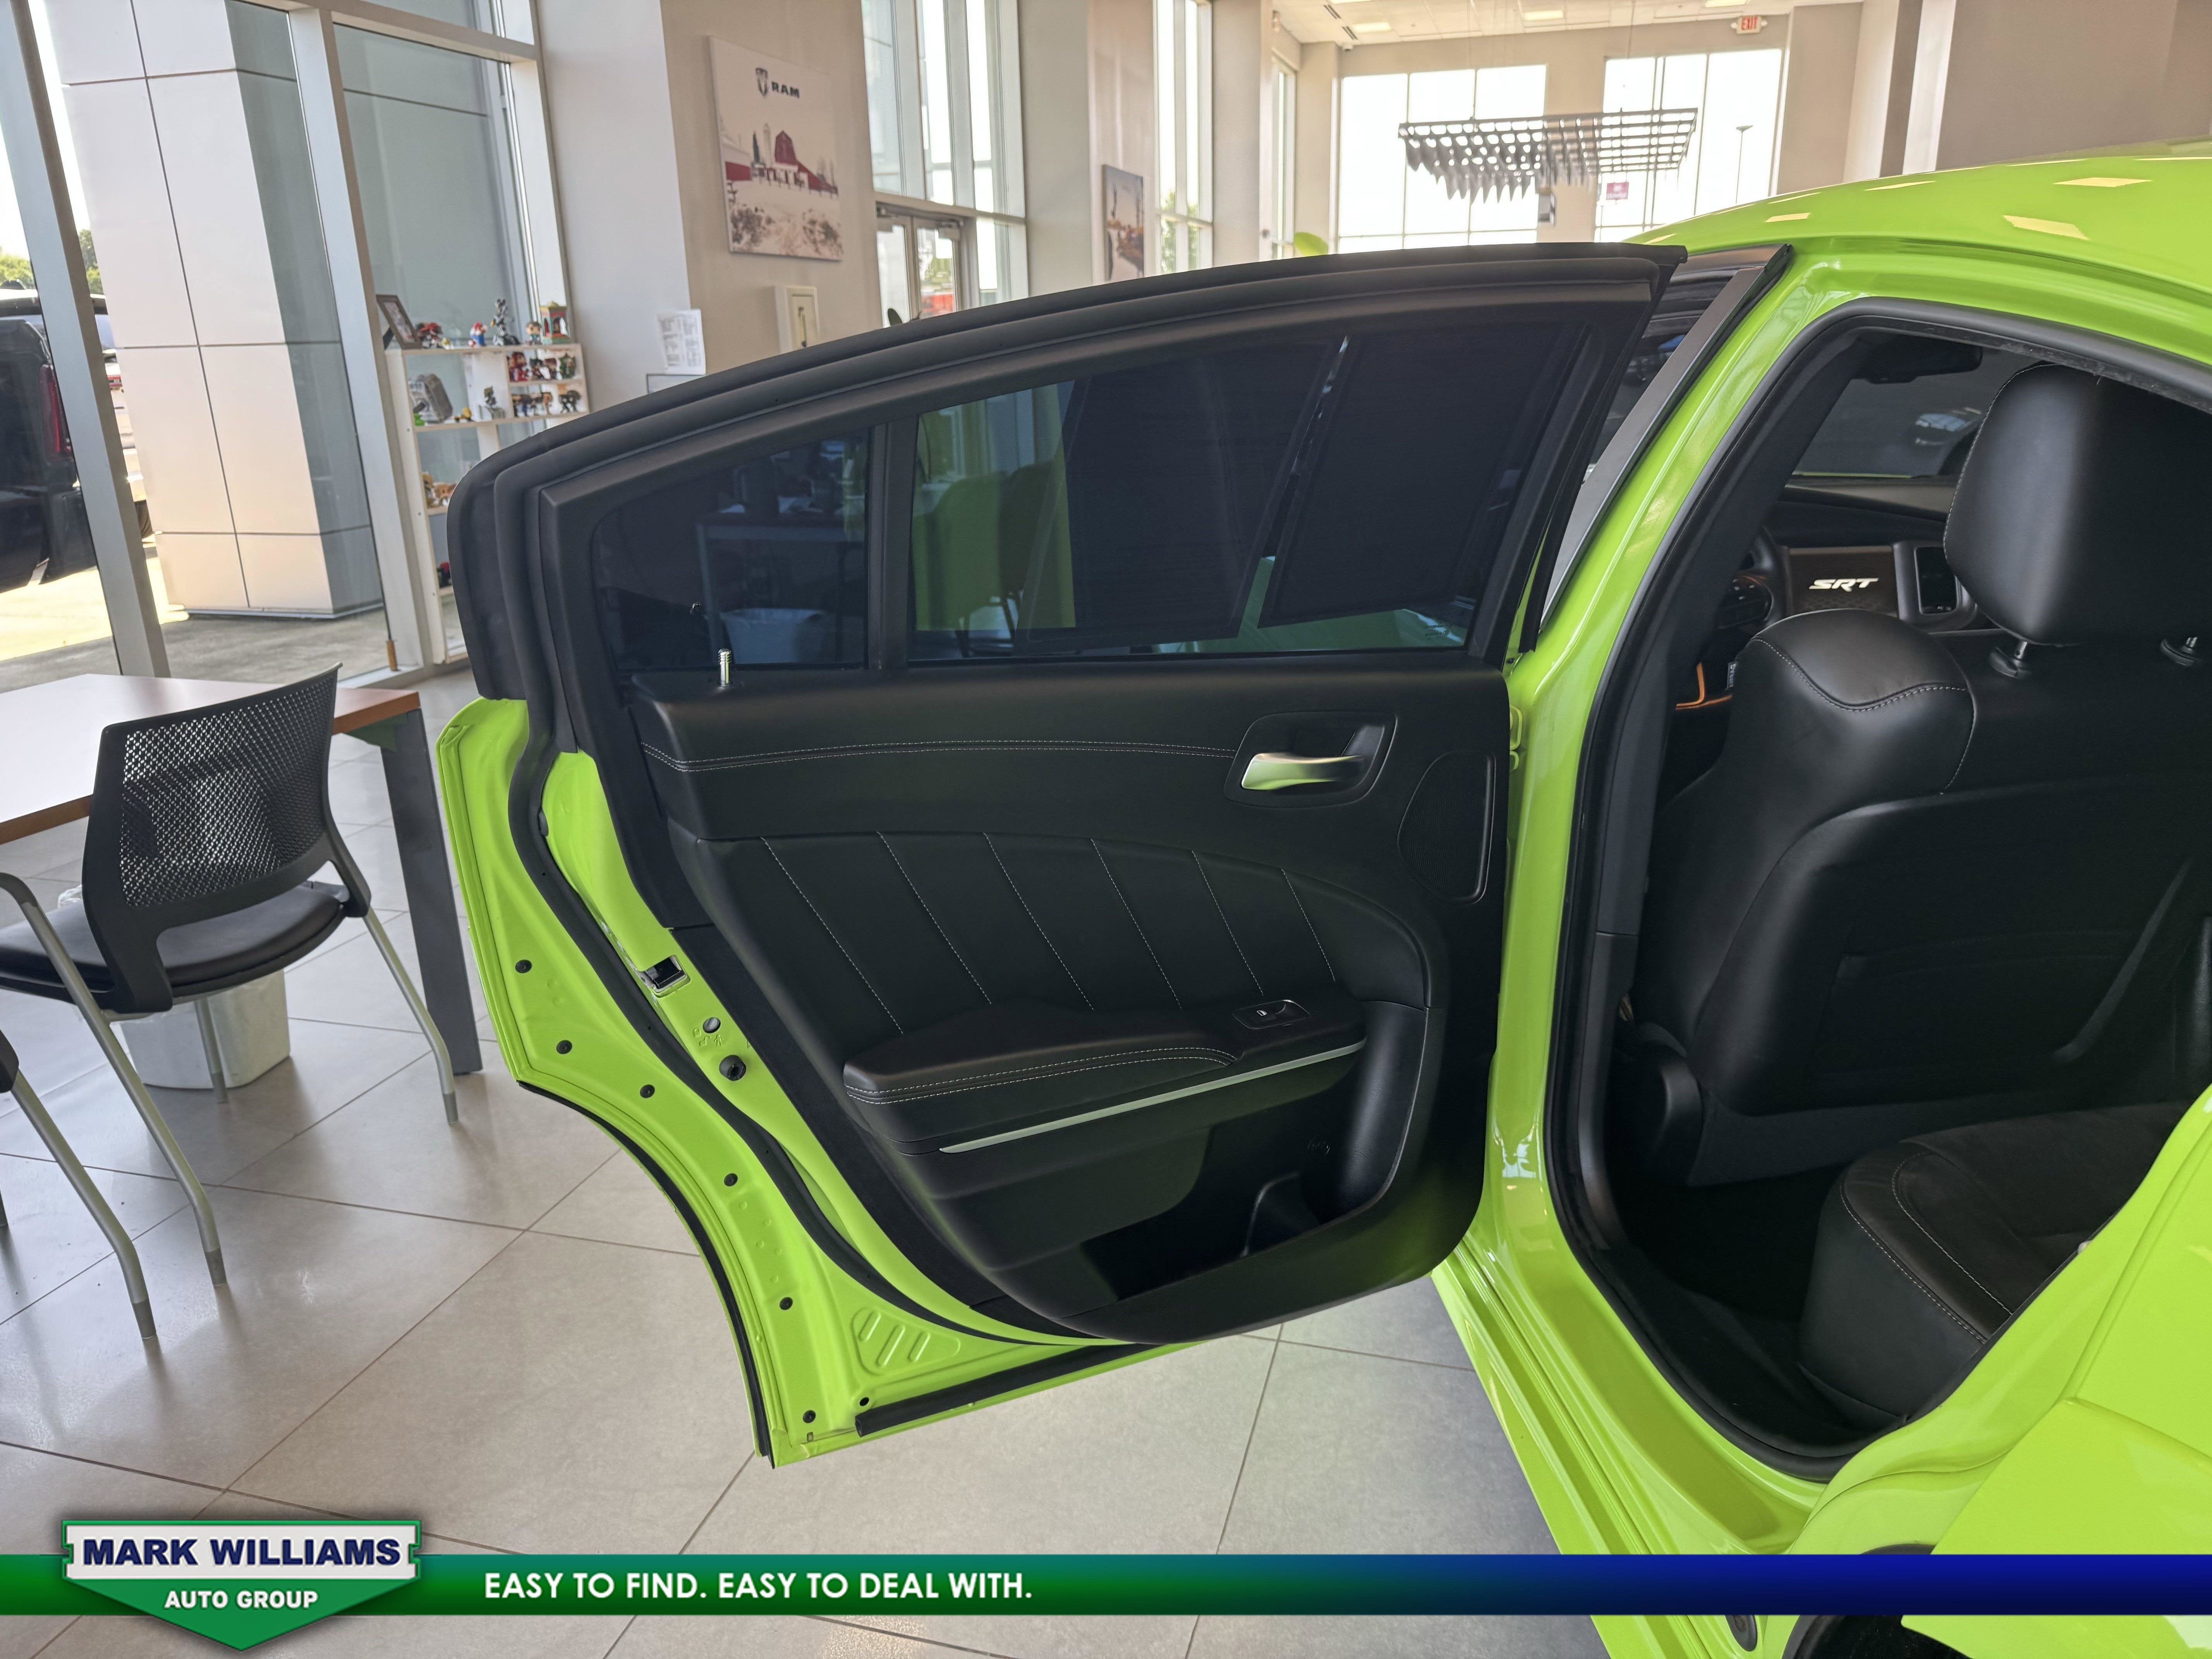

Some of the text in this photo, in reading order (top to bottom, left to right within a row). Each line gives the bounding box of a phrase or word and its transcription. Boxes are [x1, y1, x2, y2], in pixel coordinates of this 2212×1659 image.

[1741, 16, 1758, 30] EXIT
[771, 81, 800, 99] RAM
[1809, 578, 1879, 592] SRT
